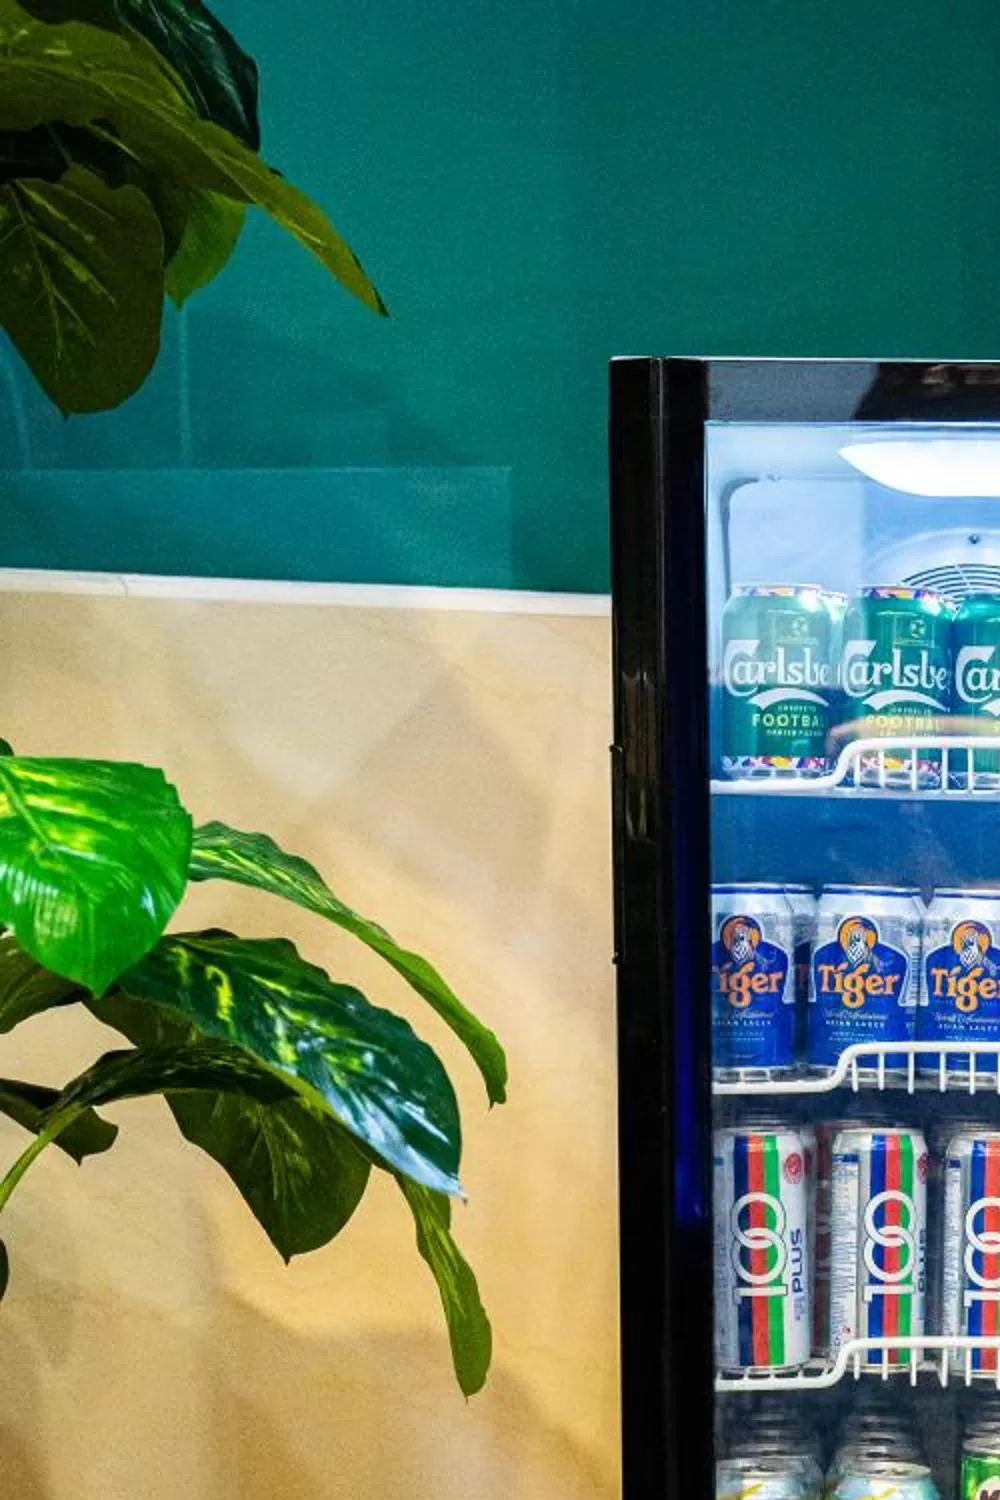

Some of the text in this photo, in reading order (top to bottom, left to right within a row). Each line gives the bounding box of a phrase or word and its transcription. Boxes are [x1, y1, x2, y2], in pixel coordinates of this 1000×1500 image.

[723, 639, 830, 697] Carlsbe
[841, 639, 950, 697] Carlsbe
[713, 962, 783, 1009] iger
[817, 962, 900, 1009] Tiger
[730, 1191, 789, 1305] 100
[790, 1228, 804, 1294] PLUS
[863, 1189, 916, 1303] 100
